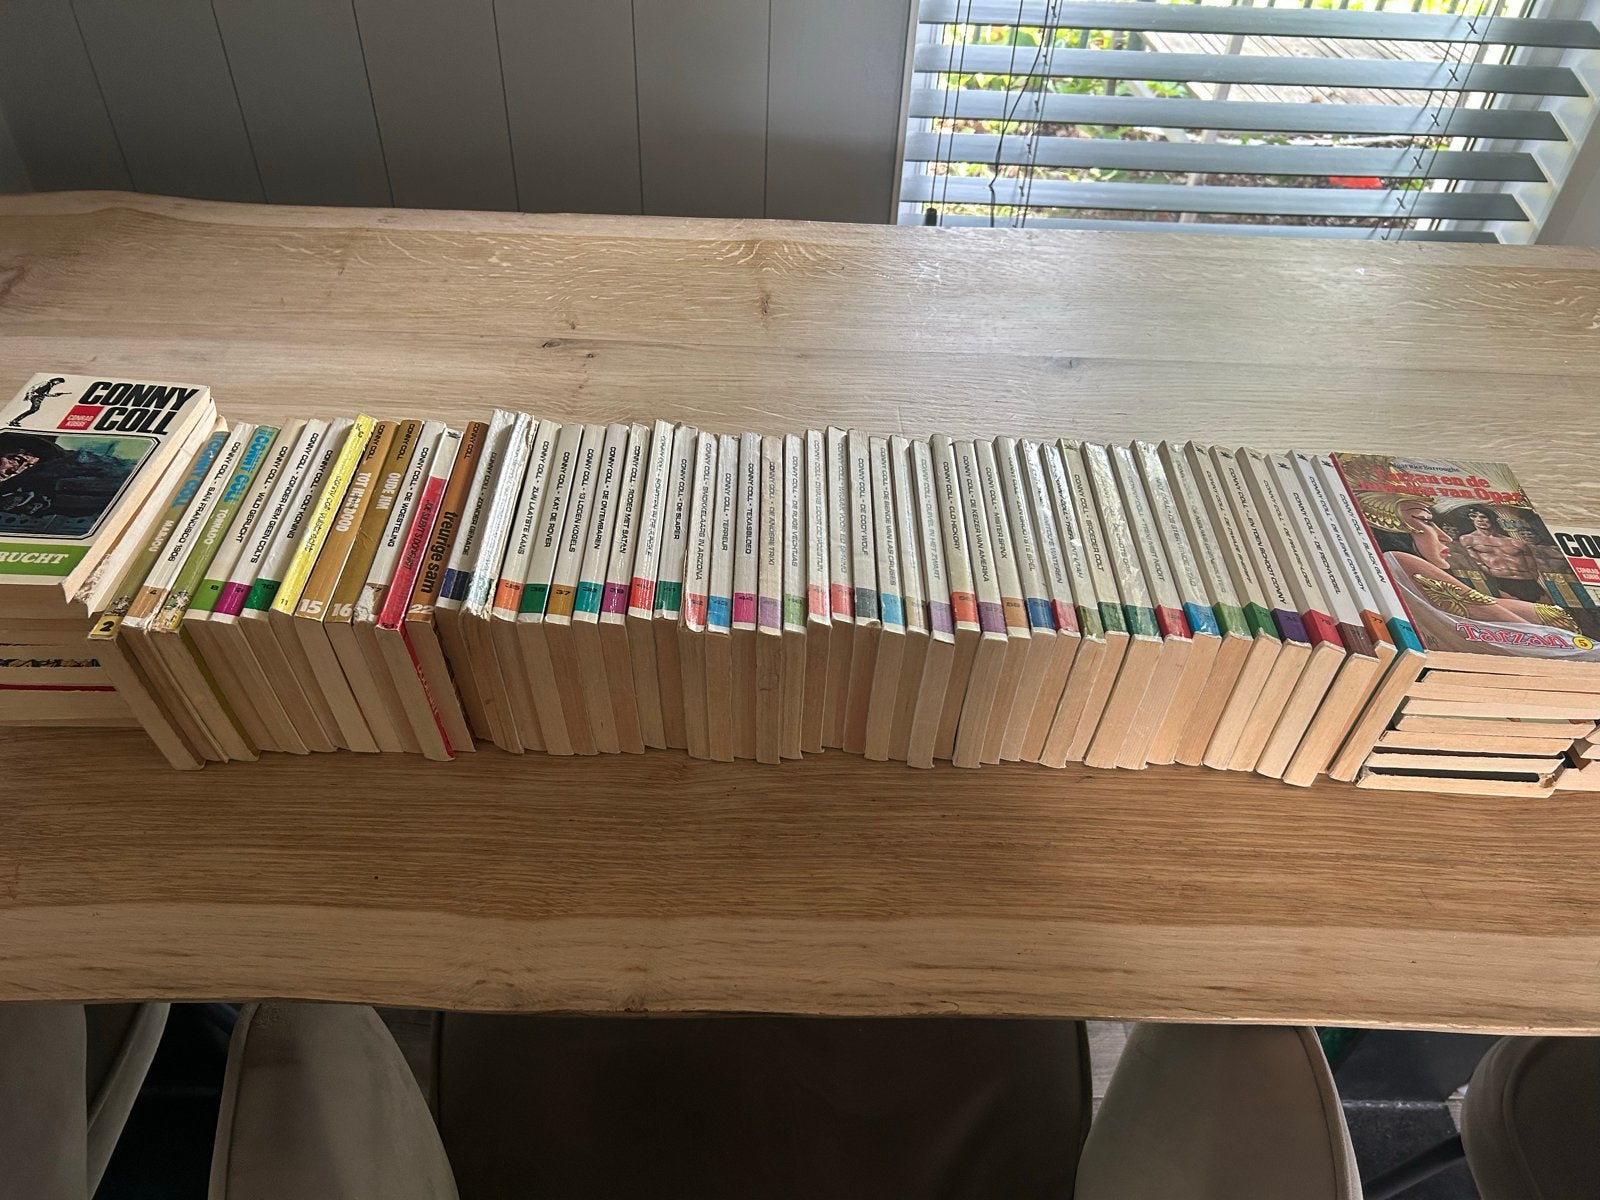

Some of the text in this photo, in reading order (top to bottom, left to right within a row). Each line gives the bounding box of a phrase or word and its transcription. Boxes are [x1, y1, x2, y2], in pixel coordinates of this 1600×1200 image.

[78, 382, 199, 410] CONNY
[94, 406, 178, 435] COLL
[371, 424, 386, 445] CONNY
[366, 445, 377, 461] COLL
[375, 423, 415, 509] CONNY COLL OUDE JIM
[560, 452, 570, 474] CONNY
[585, 448, 594, 470] CONNY
[607, 446, 616, 468] CONNY
[704, 443, 712, 464] CONNY
[962, 456, 971, 477] CONNY
[172, 441, 221, 507] CONNY COLL
[356, 472, 371, 486] TOT
[557, 474, 565, 490] COLL
[581, 470, 589, 486] COLL
[679, 459, 687, 480] CONNY
[1372, 466, 1439, 484] Tarzan
[1440, 476, 1465, 486] en
[1467, 476, 1490, 488] de
[204, 435, 269, 545] CONNY COLL TORNADO
[236, 446, 288, 543] CONNY COLL WILD GERUCHT
[250, 433, 319, 563] CONNY COLL ZONDER HEM GEEN COLTS
[287, 450, 333, 539] CONNY COLL COLT KONING
[387, 447, 428, 547] CONNY COLL DE WOESTELING
[517, 441, 549, 554] CONNY COLL ZIJN LAATSTE KANS
[620, 446, 640, 554] CONNY COLL RODEO MET SATAN
[966, 479, 974, 495] COLL
[1438, 487, 1521, 502] van Opar
[168, 442, 241, 562] CONNY COLL SAN FRANCISCO 1906
[421, 423, 480, 593] CONNY COLL treurige sam
[463, 452, 497, 555] CONNY COLL ZONDER GENADE
[574, 501, 583, 523] LODEN
[699, 486, 708, 538] SMOKKELAARS
[943, 462, 951, 484] CONNY
[951, 520, 960, 550] HICKORY
[986, 467, 994, 489] CONNY
[994, 512, 1002, 537] MISTER
[999, 538, 1007, 559] SFINX
[336, 508, 355, 532] DOOD
[594, 501, 608, 549] ONTEMBAREN
[971, 509, 980, 533] KEIZER
[1075, 474, 1085, 497] CONNY
[1086, 520, 1098, 552] BROEDER
[1095, 554, 1104, 571] COLT
[148, 520, 174, 552] MARJOU
[544, 523, 555, 547] ROVER
[569, 524, 579, 552] KOGELS
[1228, 467, 1241, 491] CONNY
[1239, 492, 1250, 509] COLL
[1252, 527, 1263, 546] TOEN
[1258, 547, 1274, 577] SCHOOT
[1270, 577, 1286, 604] CONNY
[696, 548, 704, 580] ARIZONA
[978, 549, 989, 582] AMERIKA
[298, 600, 323, 613] 15
[332, 603, 352, 616] 16
[408, 604, 434, 614] 22
[100, 620, 114, 632] 2
[1456, 623, 1574, 650] Tarzan
[1578, 639, 1588, 648] 5
